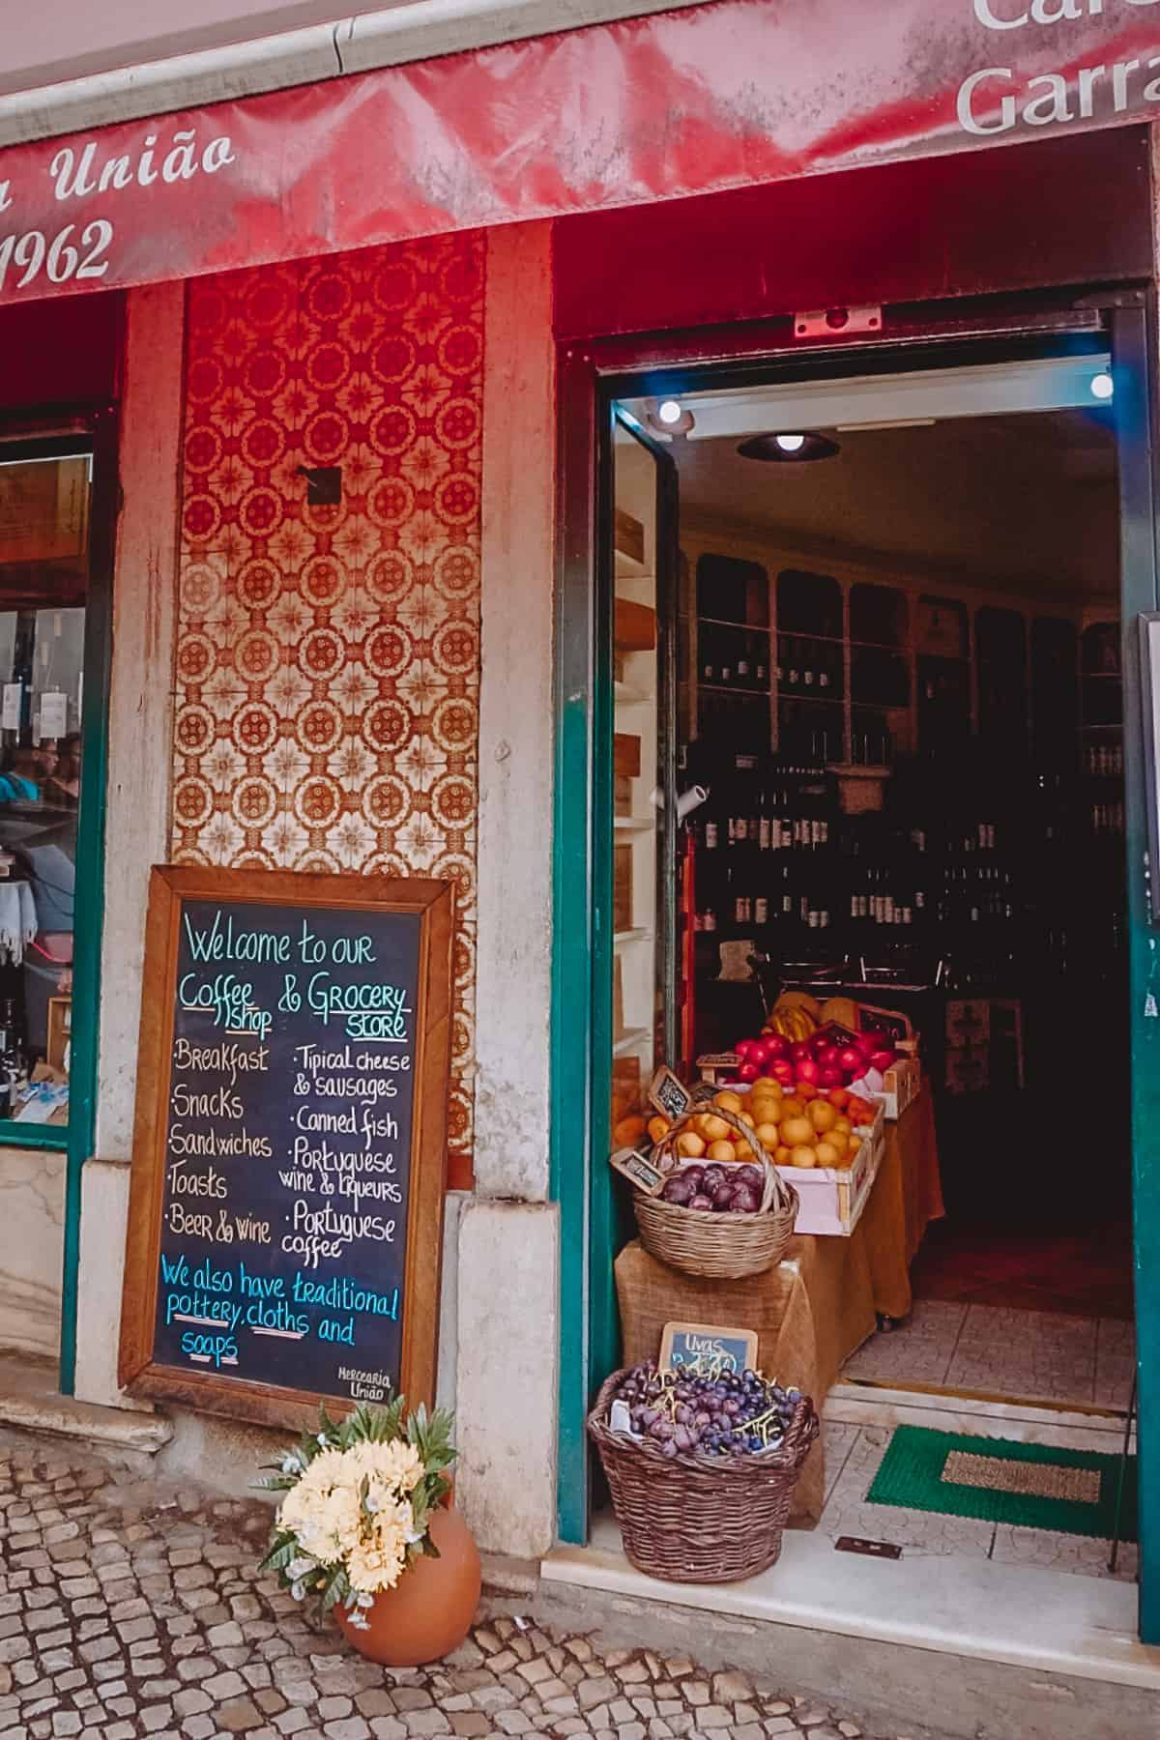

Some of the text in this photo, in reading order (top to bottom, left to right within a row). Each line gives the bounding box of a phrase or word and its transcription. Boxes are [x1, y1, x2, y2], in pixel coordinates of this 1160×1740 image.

[50, 129, 236, 201] União
[184, 909, 291, 963] Welcome
[298, 919, 327, 963] to
[179, 972, 256, 1028] Coffee
[278, 973, 301, 1013] &
[295, 1043, 411, 1080] Tipical cheese
[173, 1083, 244, 1119] Snacks
[293, 1072, 398, 1105] & sausages
[170, 1123, 273, 1158] Sandwiches
[296, 1105, 399, 1150] Canned fish
[169, 1159, 228, 1199] Toasts
[277, 1166, 316, 1192] wine
[235, 1212, 272, 1245] wine
[281, 1235, 343, 1269] coffee
[161, 1253, 189, 1287] We
[193, 1257, 233, 1292] also
[240, 1261, 286, 1299] have
[246, 1300, 310, 1335] cloths
[318, 1317, 356, 1346] and
[181, 1331, 240, 1369] soaps
[685, 1332, 722, 1353] Uvas
[350, 1381, 385, 1402] União
